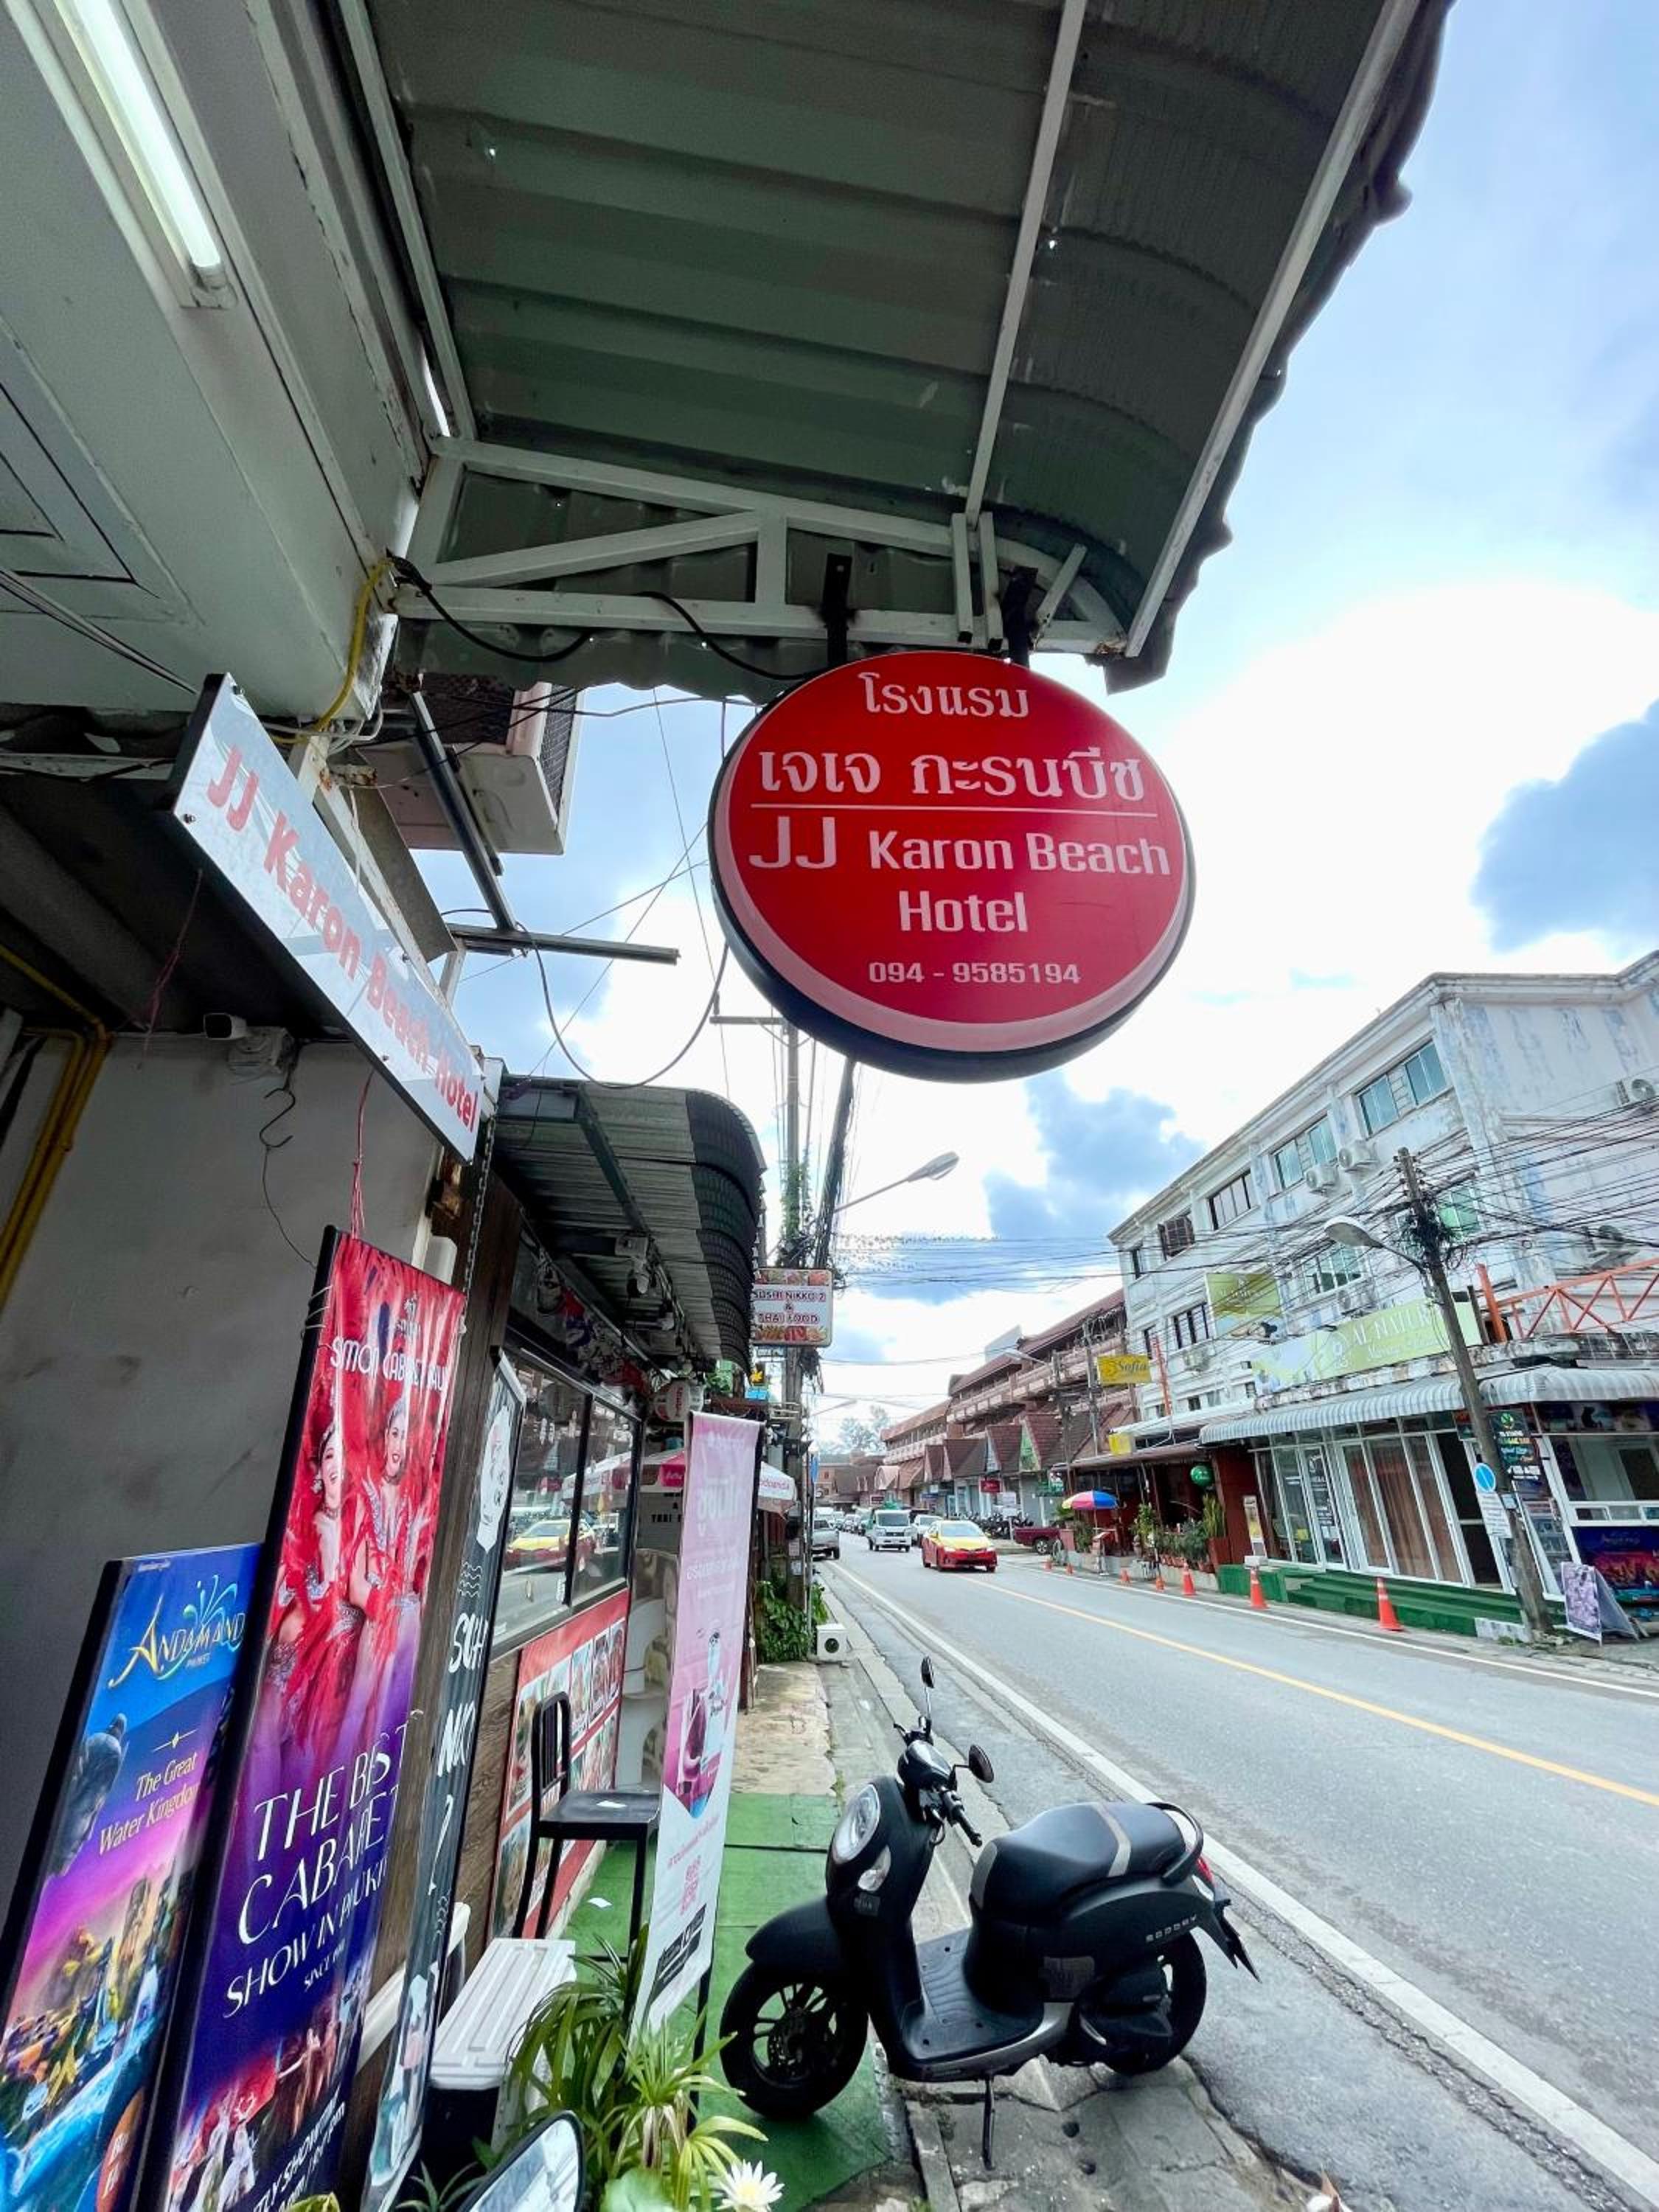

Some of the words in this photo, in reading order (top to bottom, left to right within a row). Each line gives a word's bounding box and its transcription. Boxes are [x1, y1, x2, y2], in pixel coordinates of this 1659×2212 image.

[858, 672, 1029, 718] โรงแรม
[759, 751, 881, 793] เจเจ
[911, 746, 1144, 801] กะรนบีช
[748, 815, 837, 870] JJ
[869, 830, 1015, 870] Karon
[1026, 832, 1172, 875] Beach
[898, 890, 1029, 933] Hotel
[207, 745, 260, 832] JJ
[263, 810, 363, 981] Karon
[366, 951, 431, 1073] Beach
[434, 1054, 479, 1134] Hotel
[869, 962, 925, 983] 094
[952, 963, 1081, 984] 9585194
[136, 1771, 161, 1802] The
[163, 1751, 198, 1786] Great
[100, 1813, 145, 1856] Water
[254, 1764, 345, 1862] THE
[223, 1923, 317, 2020] SHOW
